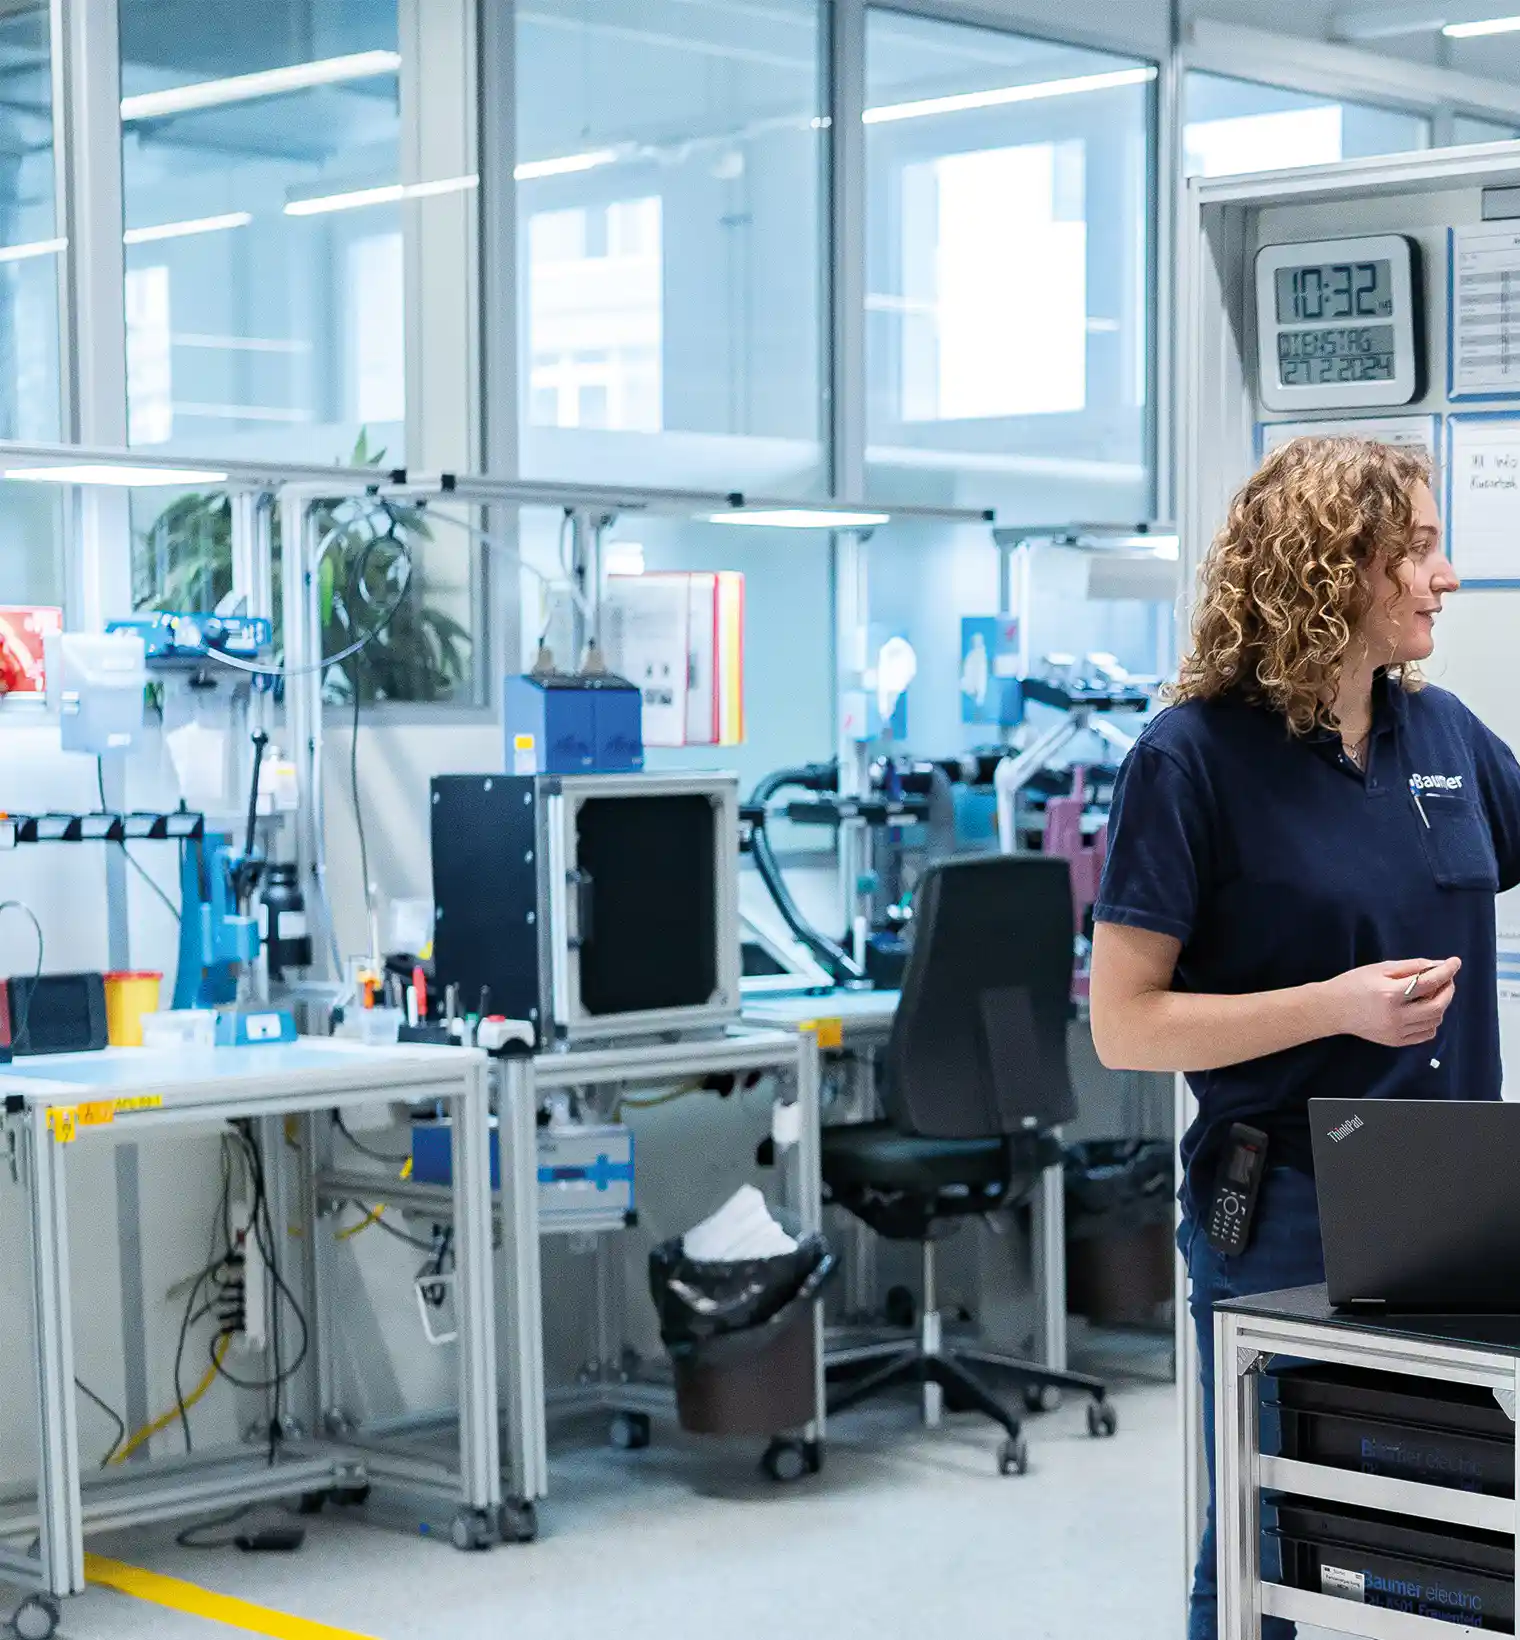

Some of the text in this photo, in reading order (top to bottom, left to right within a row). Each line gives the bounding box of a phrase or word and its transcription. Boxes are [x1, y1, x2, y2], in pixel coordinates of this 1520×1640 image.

[1292, 263, 1377, 318] 10:32
[1411, 773, 1462, 789] Baumer
[1327, 1114, 1364, 1142] ThinkPad
[1362, 1569, 1421, 1597] Baumer
[1425, 1582, 1482, 1610] electric
